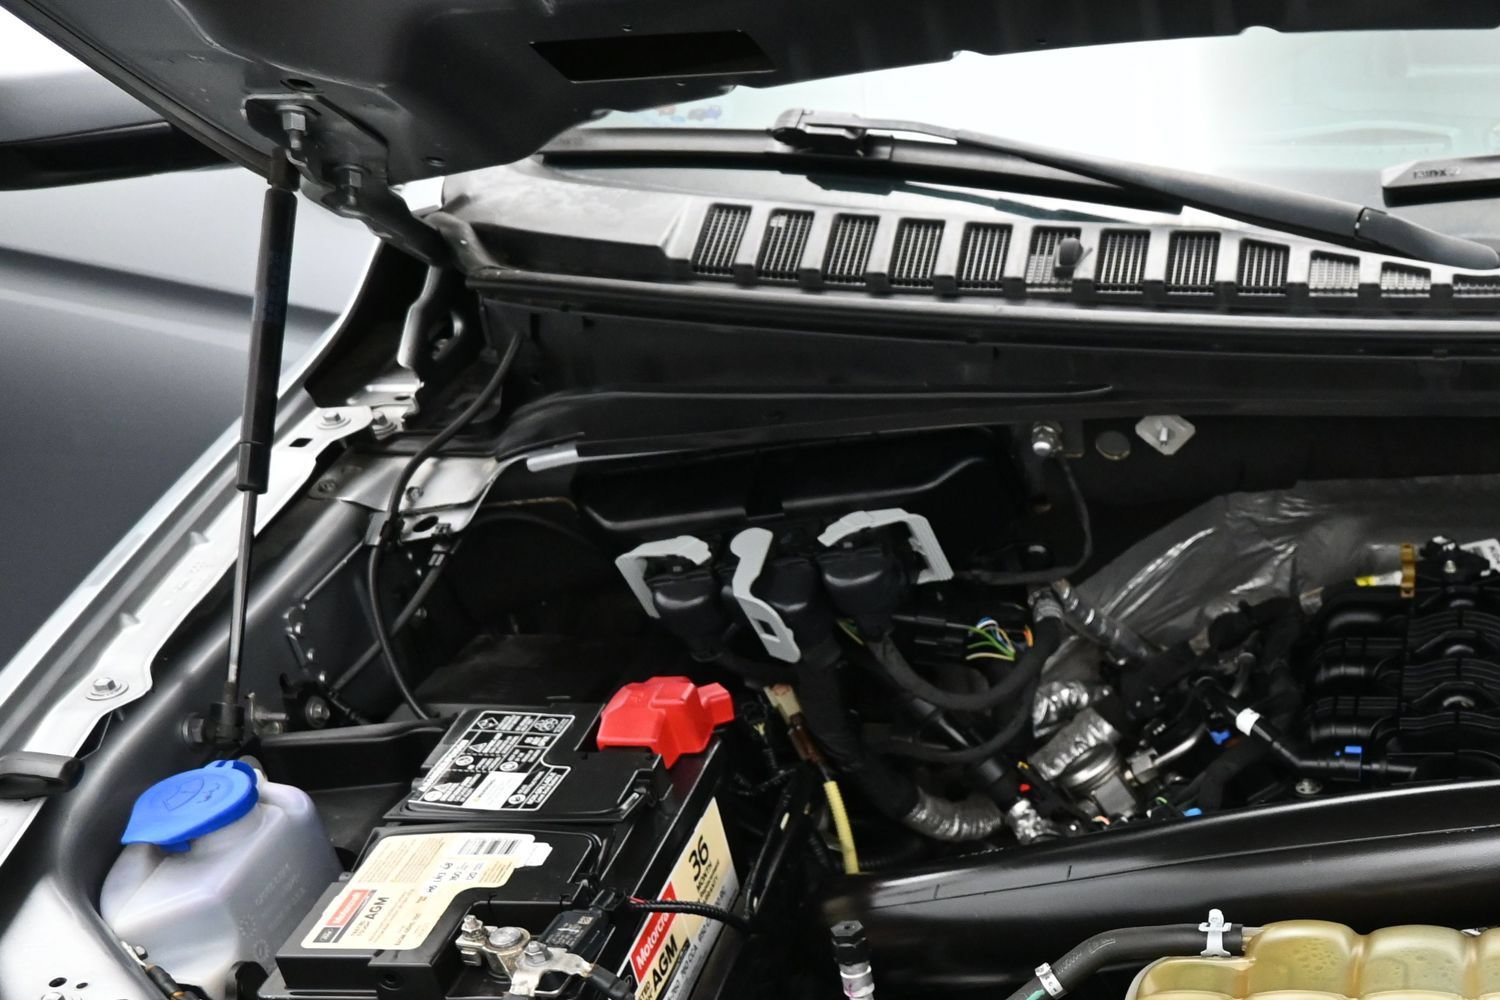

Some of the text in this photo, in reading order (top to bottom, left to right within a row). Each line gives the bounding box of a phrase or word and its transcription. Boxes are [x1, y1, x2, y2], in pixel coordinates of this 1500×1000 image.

[688, 835, 709, 882] 36
[365, 896, 390, 920] AGM
[636, 898, 673, 970] Motorcra
[651, 934, 678, 992] AGM
